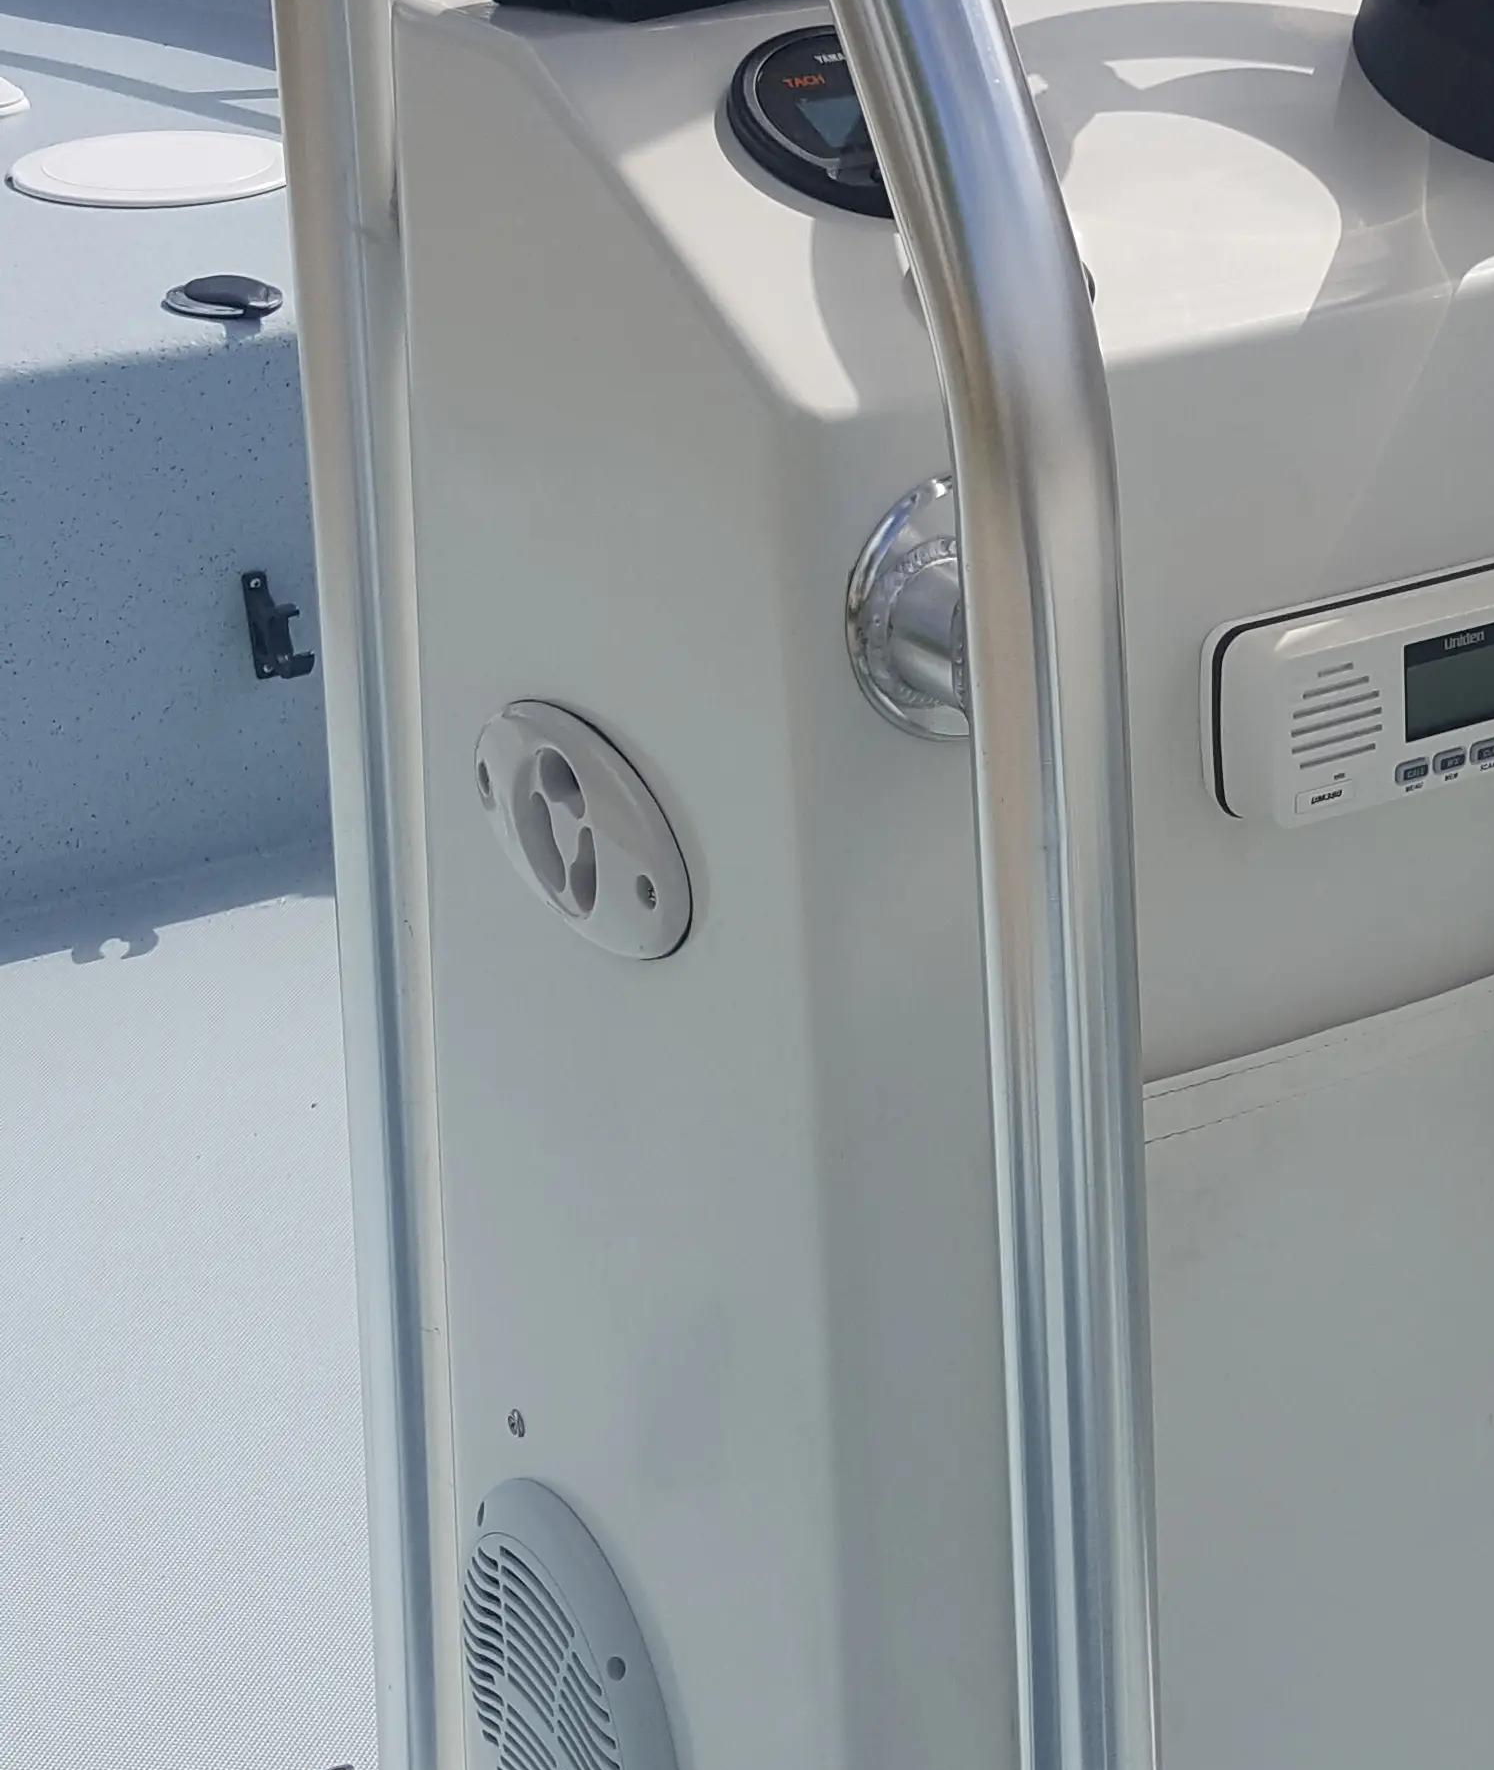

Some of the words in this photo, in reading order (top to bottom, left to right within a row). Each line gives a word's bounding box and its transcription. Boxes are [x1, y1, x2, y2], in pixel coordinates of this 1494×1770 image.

[813, 52, 846, 65] YAMA
[782, 74, 826, 88] TACH
[1444, 630, 1485, 651] Uniden
